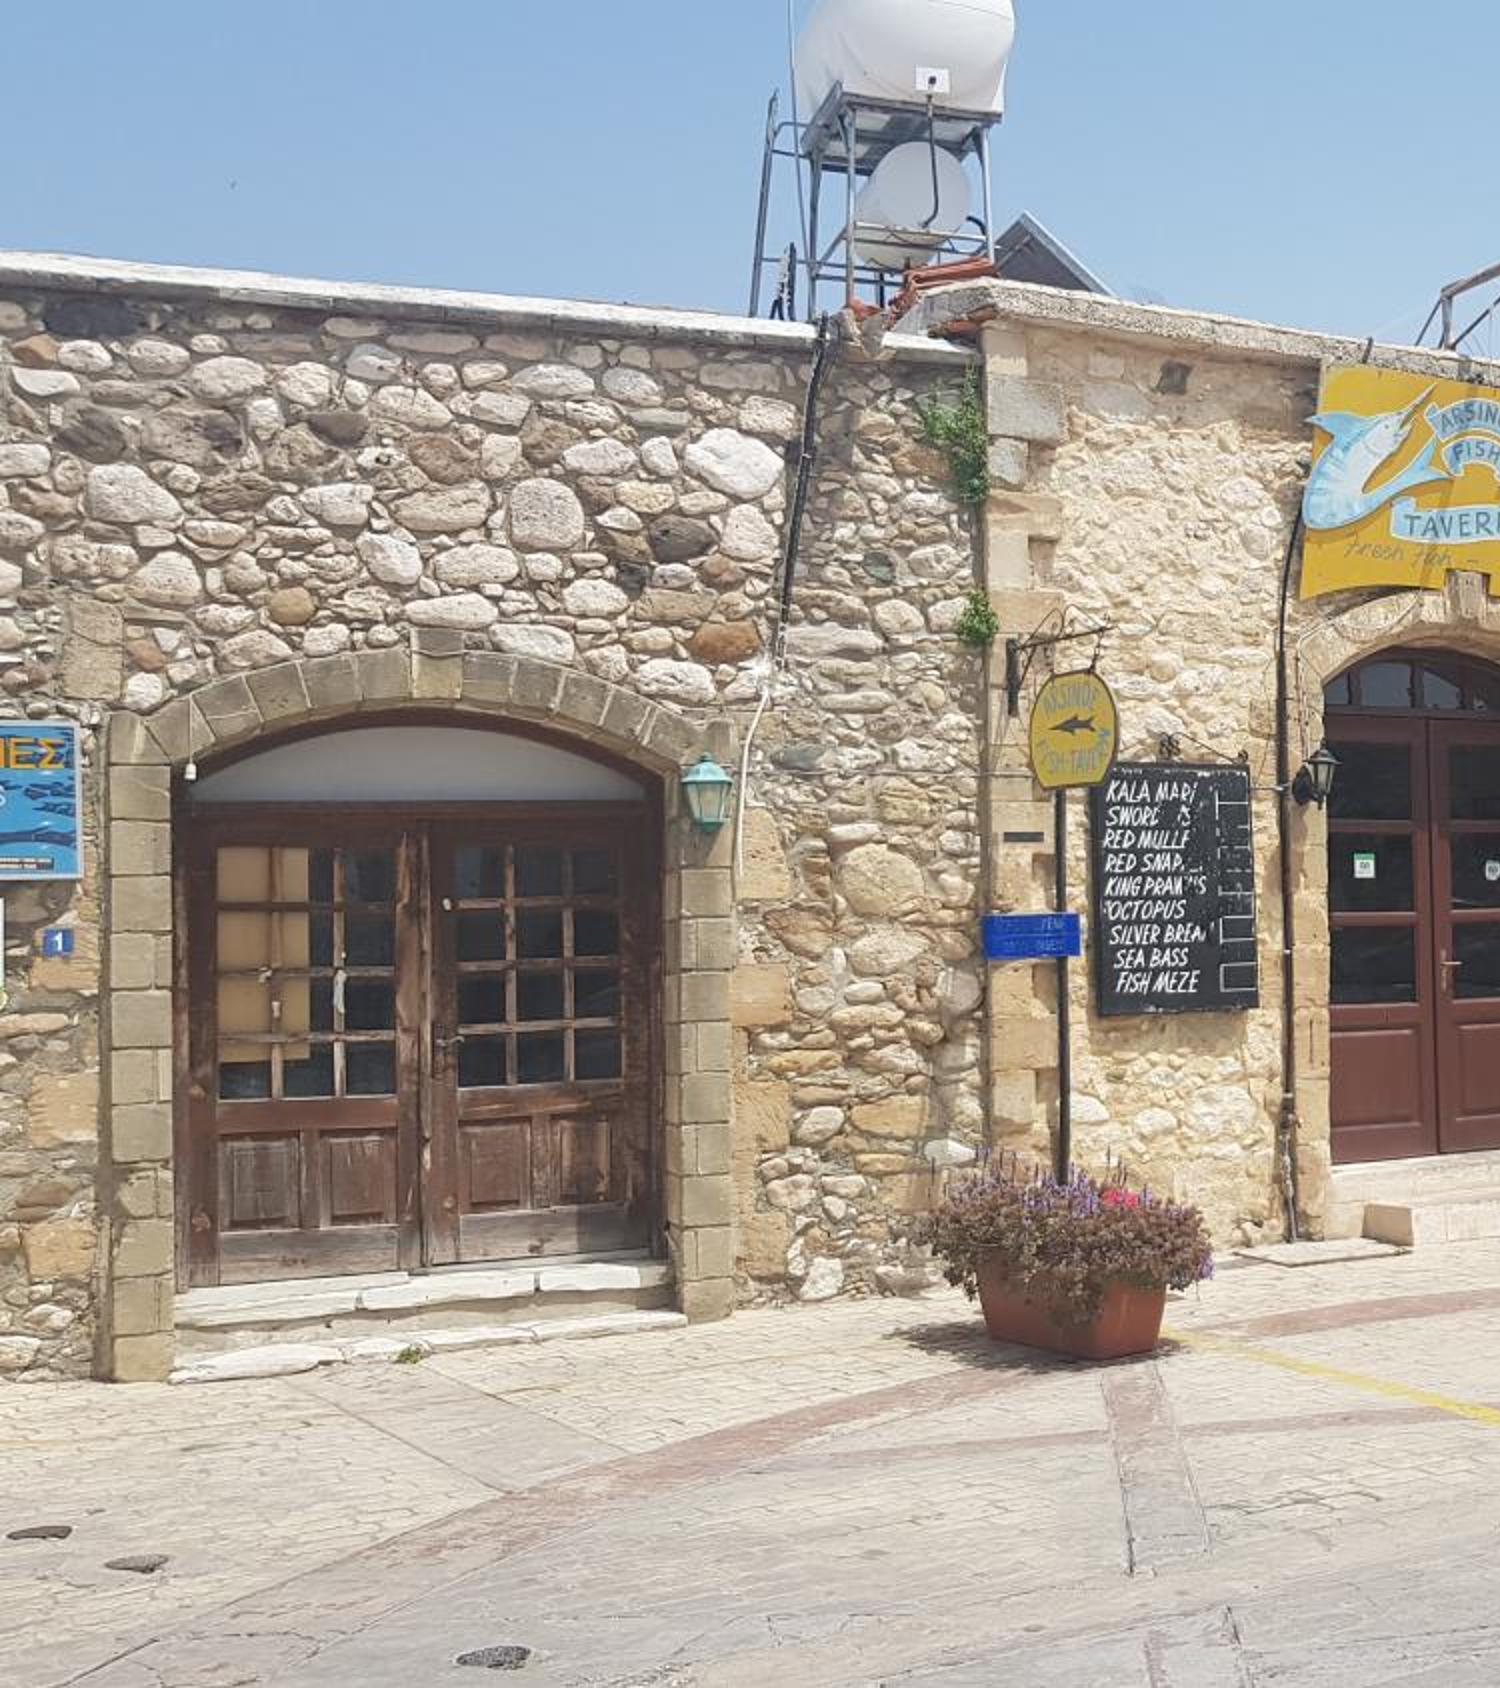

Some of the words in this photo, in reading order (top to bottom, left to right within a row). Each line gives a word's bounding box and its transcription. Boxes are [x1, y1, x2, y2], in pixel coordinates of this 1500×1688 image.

[1105, 779, 1151, 803] KALA
[1102, 829, 1136, 849] RED
[1104, 853, 1137, 873] RED
[1104, 876, 1143, 897] KING
[1108, 899, 1187, 921] OCTOPUS
[53, 932, 63, 952] 1
[1109, 923, 1161, 945] SILVER
[1113, 948, 1145, 969] SEA
[1149, 948, 1189, 969] BASS
[1115, 971, 1152, 994] FISH
[1152, 970, 1200, 993] MEZE
